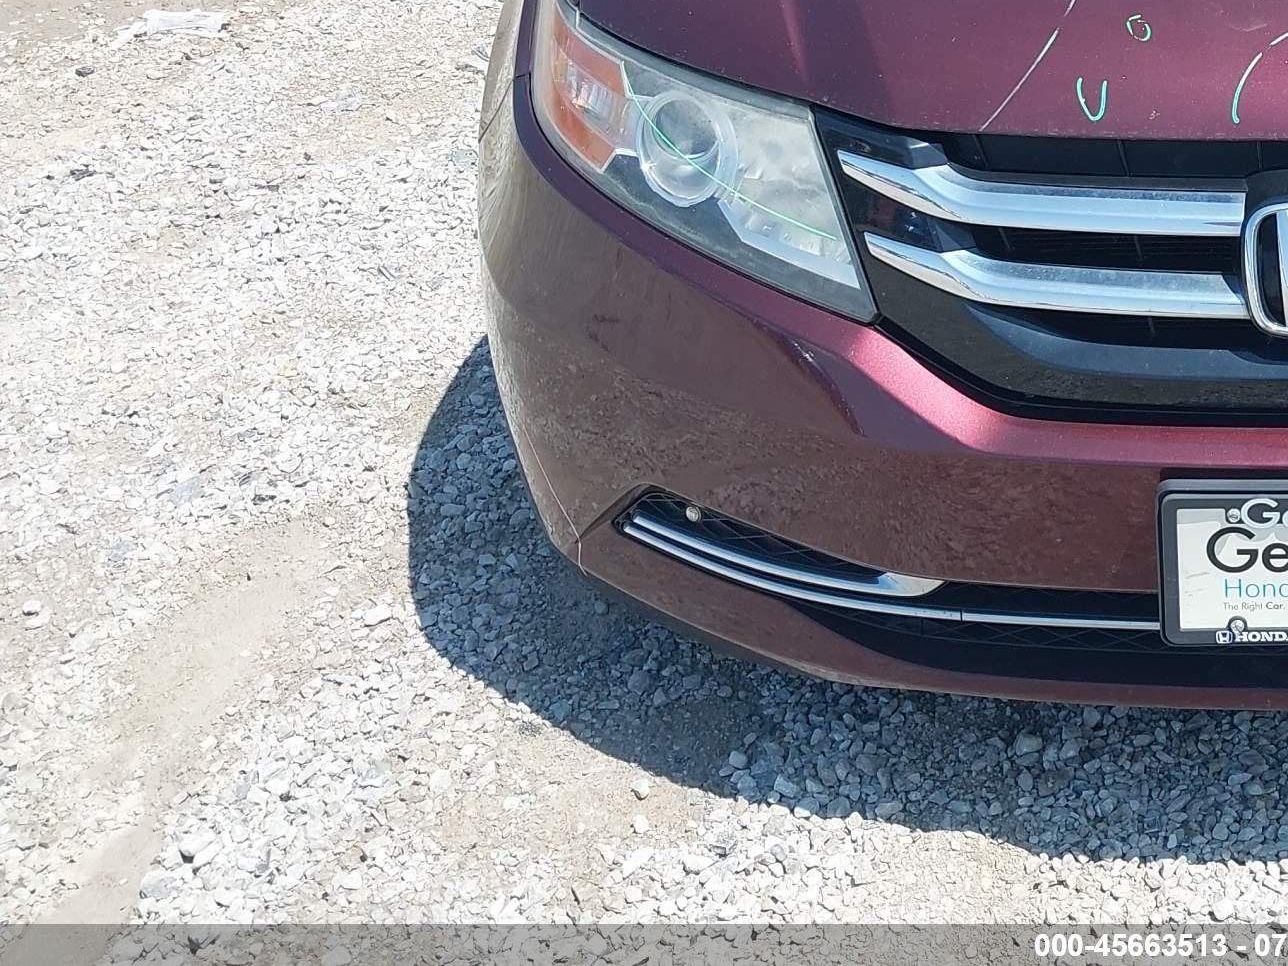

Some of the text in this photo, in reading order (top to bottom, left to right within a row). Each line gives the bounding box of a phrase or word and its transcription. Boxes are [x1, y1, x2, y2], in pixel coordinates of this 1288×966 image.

[1223, 602, 1239, 611] The
[1241, 602, 1263, 612] Right
[1265, 602, 1286, 611] Car.
